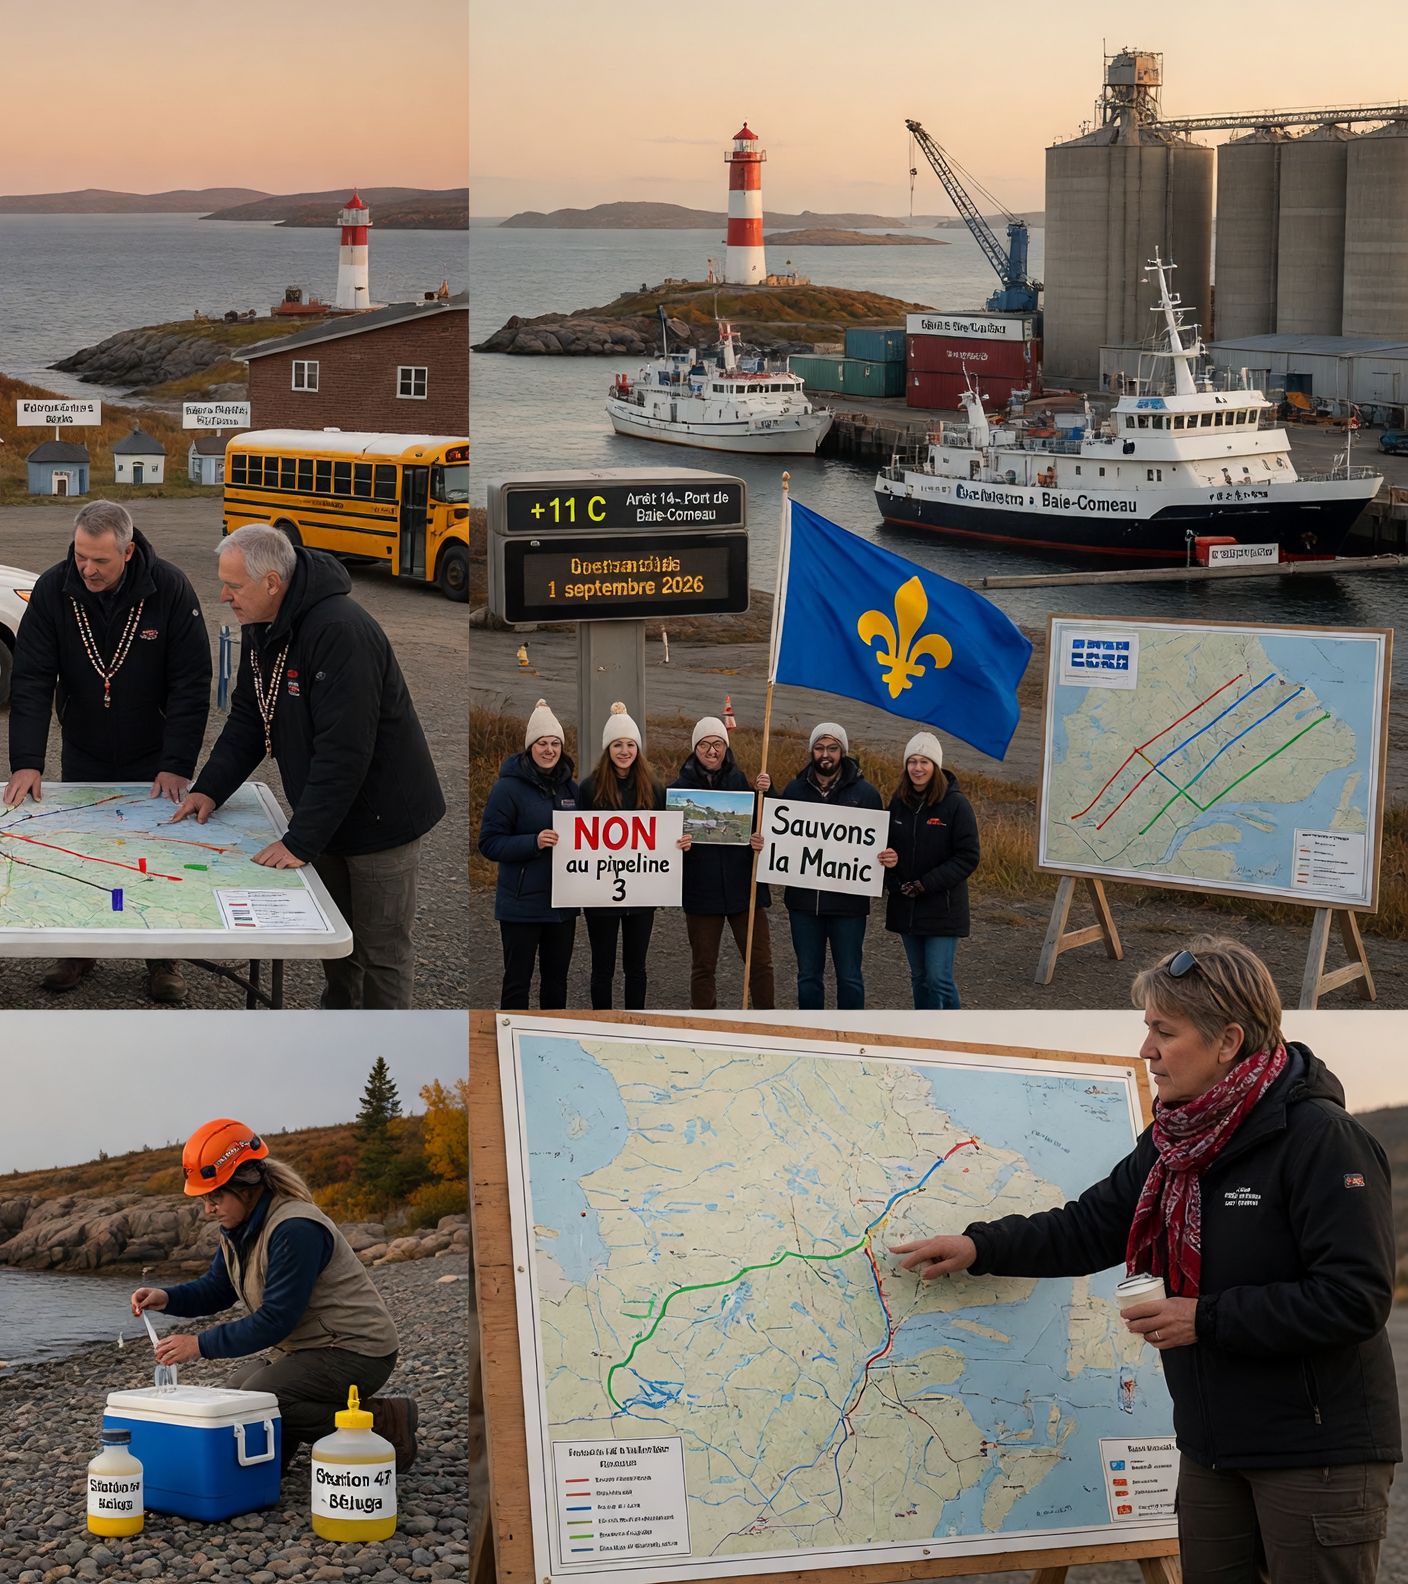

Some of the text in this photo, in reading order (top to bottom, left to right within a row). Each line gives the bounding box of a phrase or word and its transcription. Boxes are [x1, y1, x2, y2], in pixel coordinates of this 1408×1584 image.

[531, 495, 607, 523] +11 C
[684, 491, 710, 505] Port
[713, 491, 729, 504] de
[548, 576, 705, 600] 1 septembre 2026
[574, 816, 657, 851] NON
[771, 805, 876, 847] Sauvons
[566, 852, 670, 880] au pipeline
[768, 842, 872, 883] la Manic
[611, 878, 627, 902] 3
